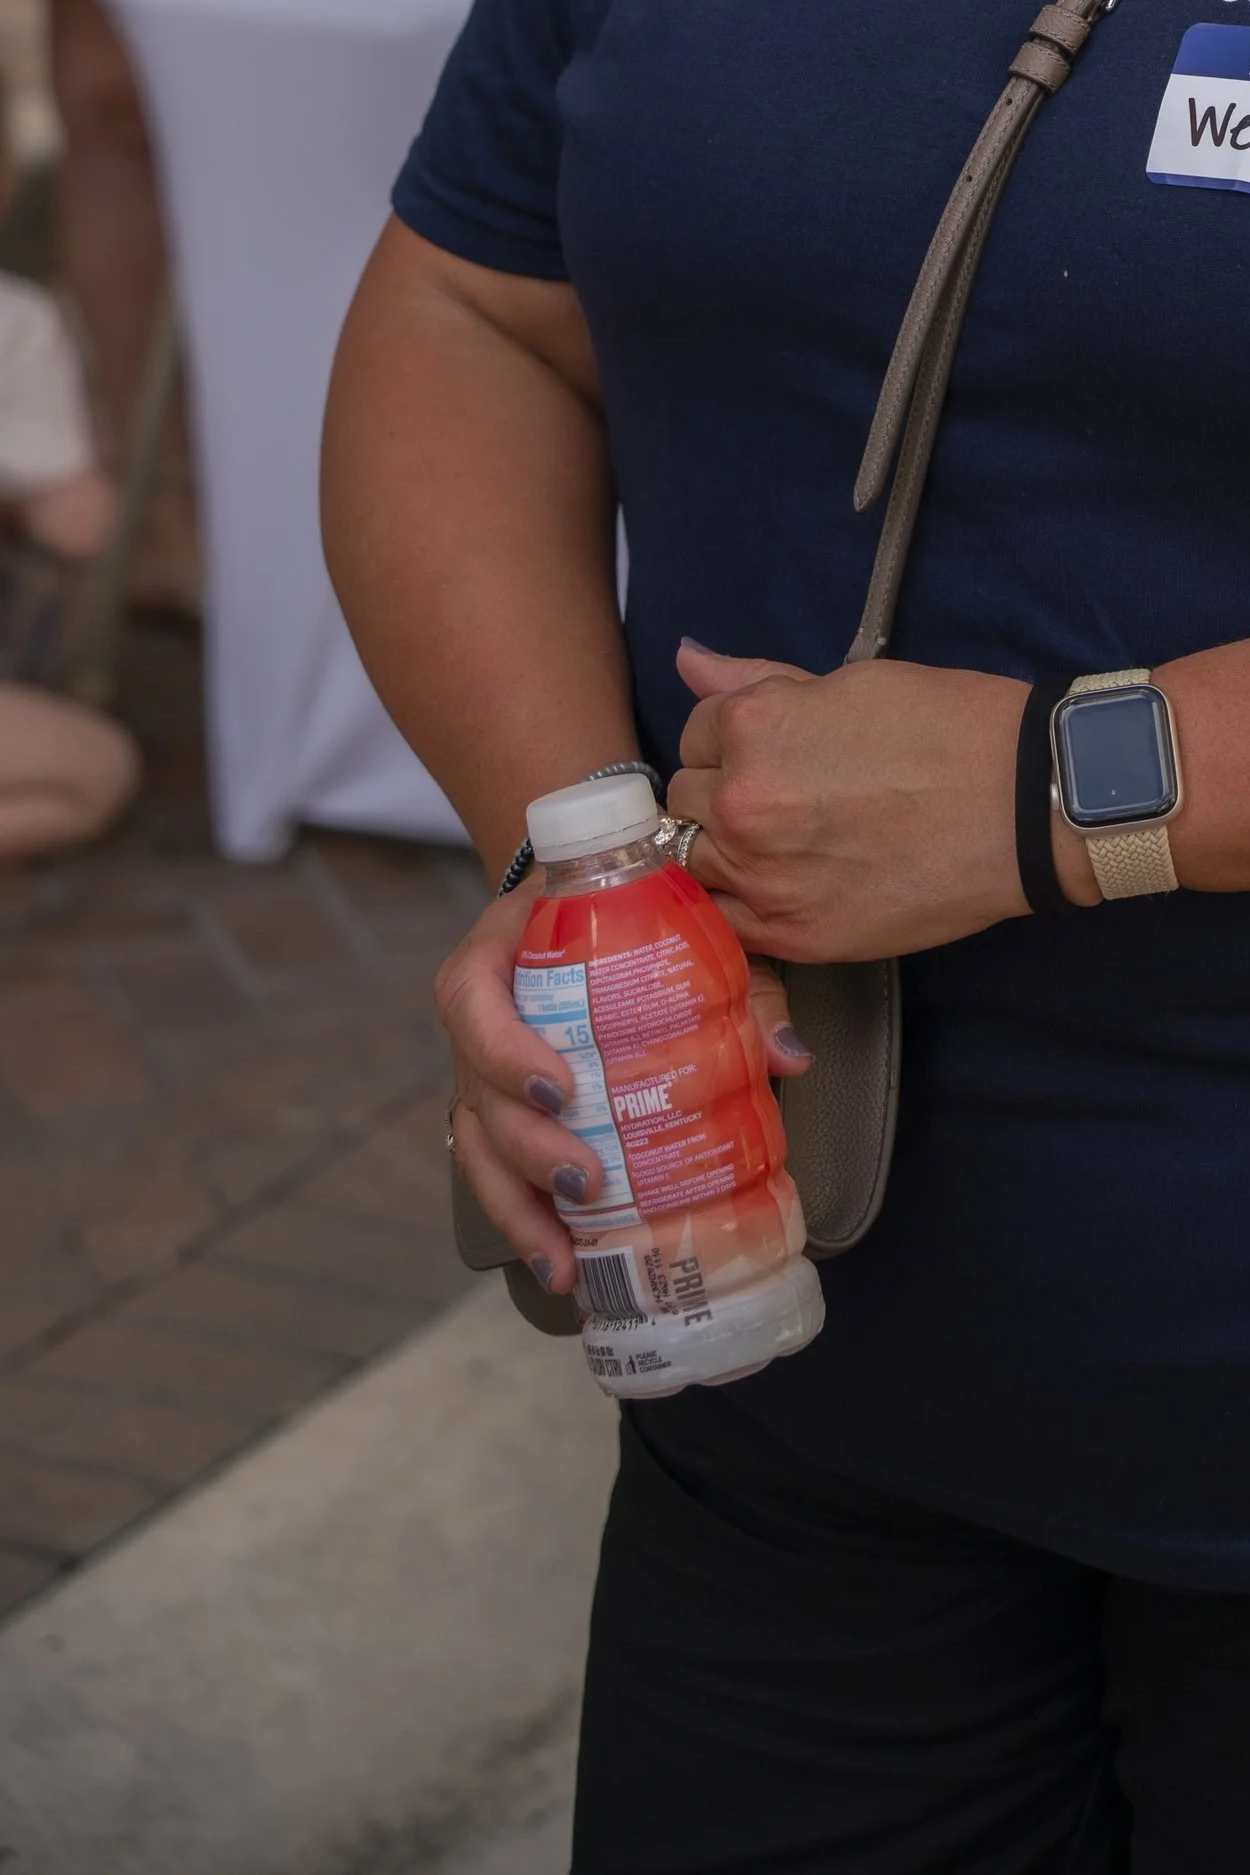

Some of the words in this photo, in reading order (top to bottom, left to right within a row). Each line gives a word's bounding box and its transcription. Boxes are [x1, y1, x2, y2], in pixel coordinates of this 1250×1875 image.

[547, 968, 585, 987] Facts
[565, 1026, 591, 1046] 15
[611, 1070, 678, 1094] MANUFACTURED
[678, 1064, 697, 1076] FOR:
[621, 1116, 666, 1131] HYDRATION,
[667, 1110, 682, 1120] LLC
[665, 1111, 702, 1129] KENTUCKY
[669, 1256, 713, 1326] PRIME
